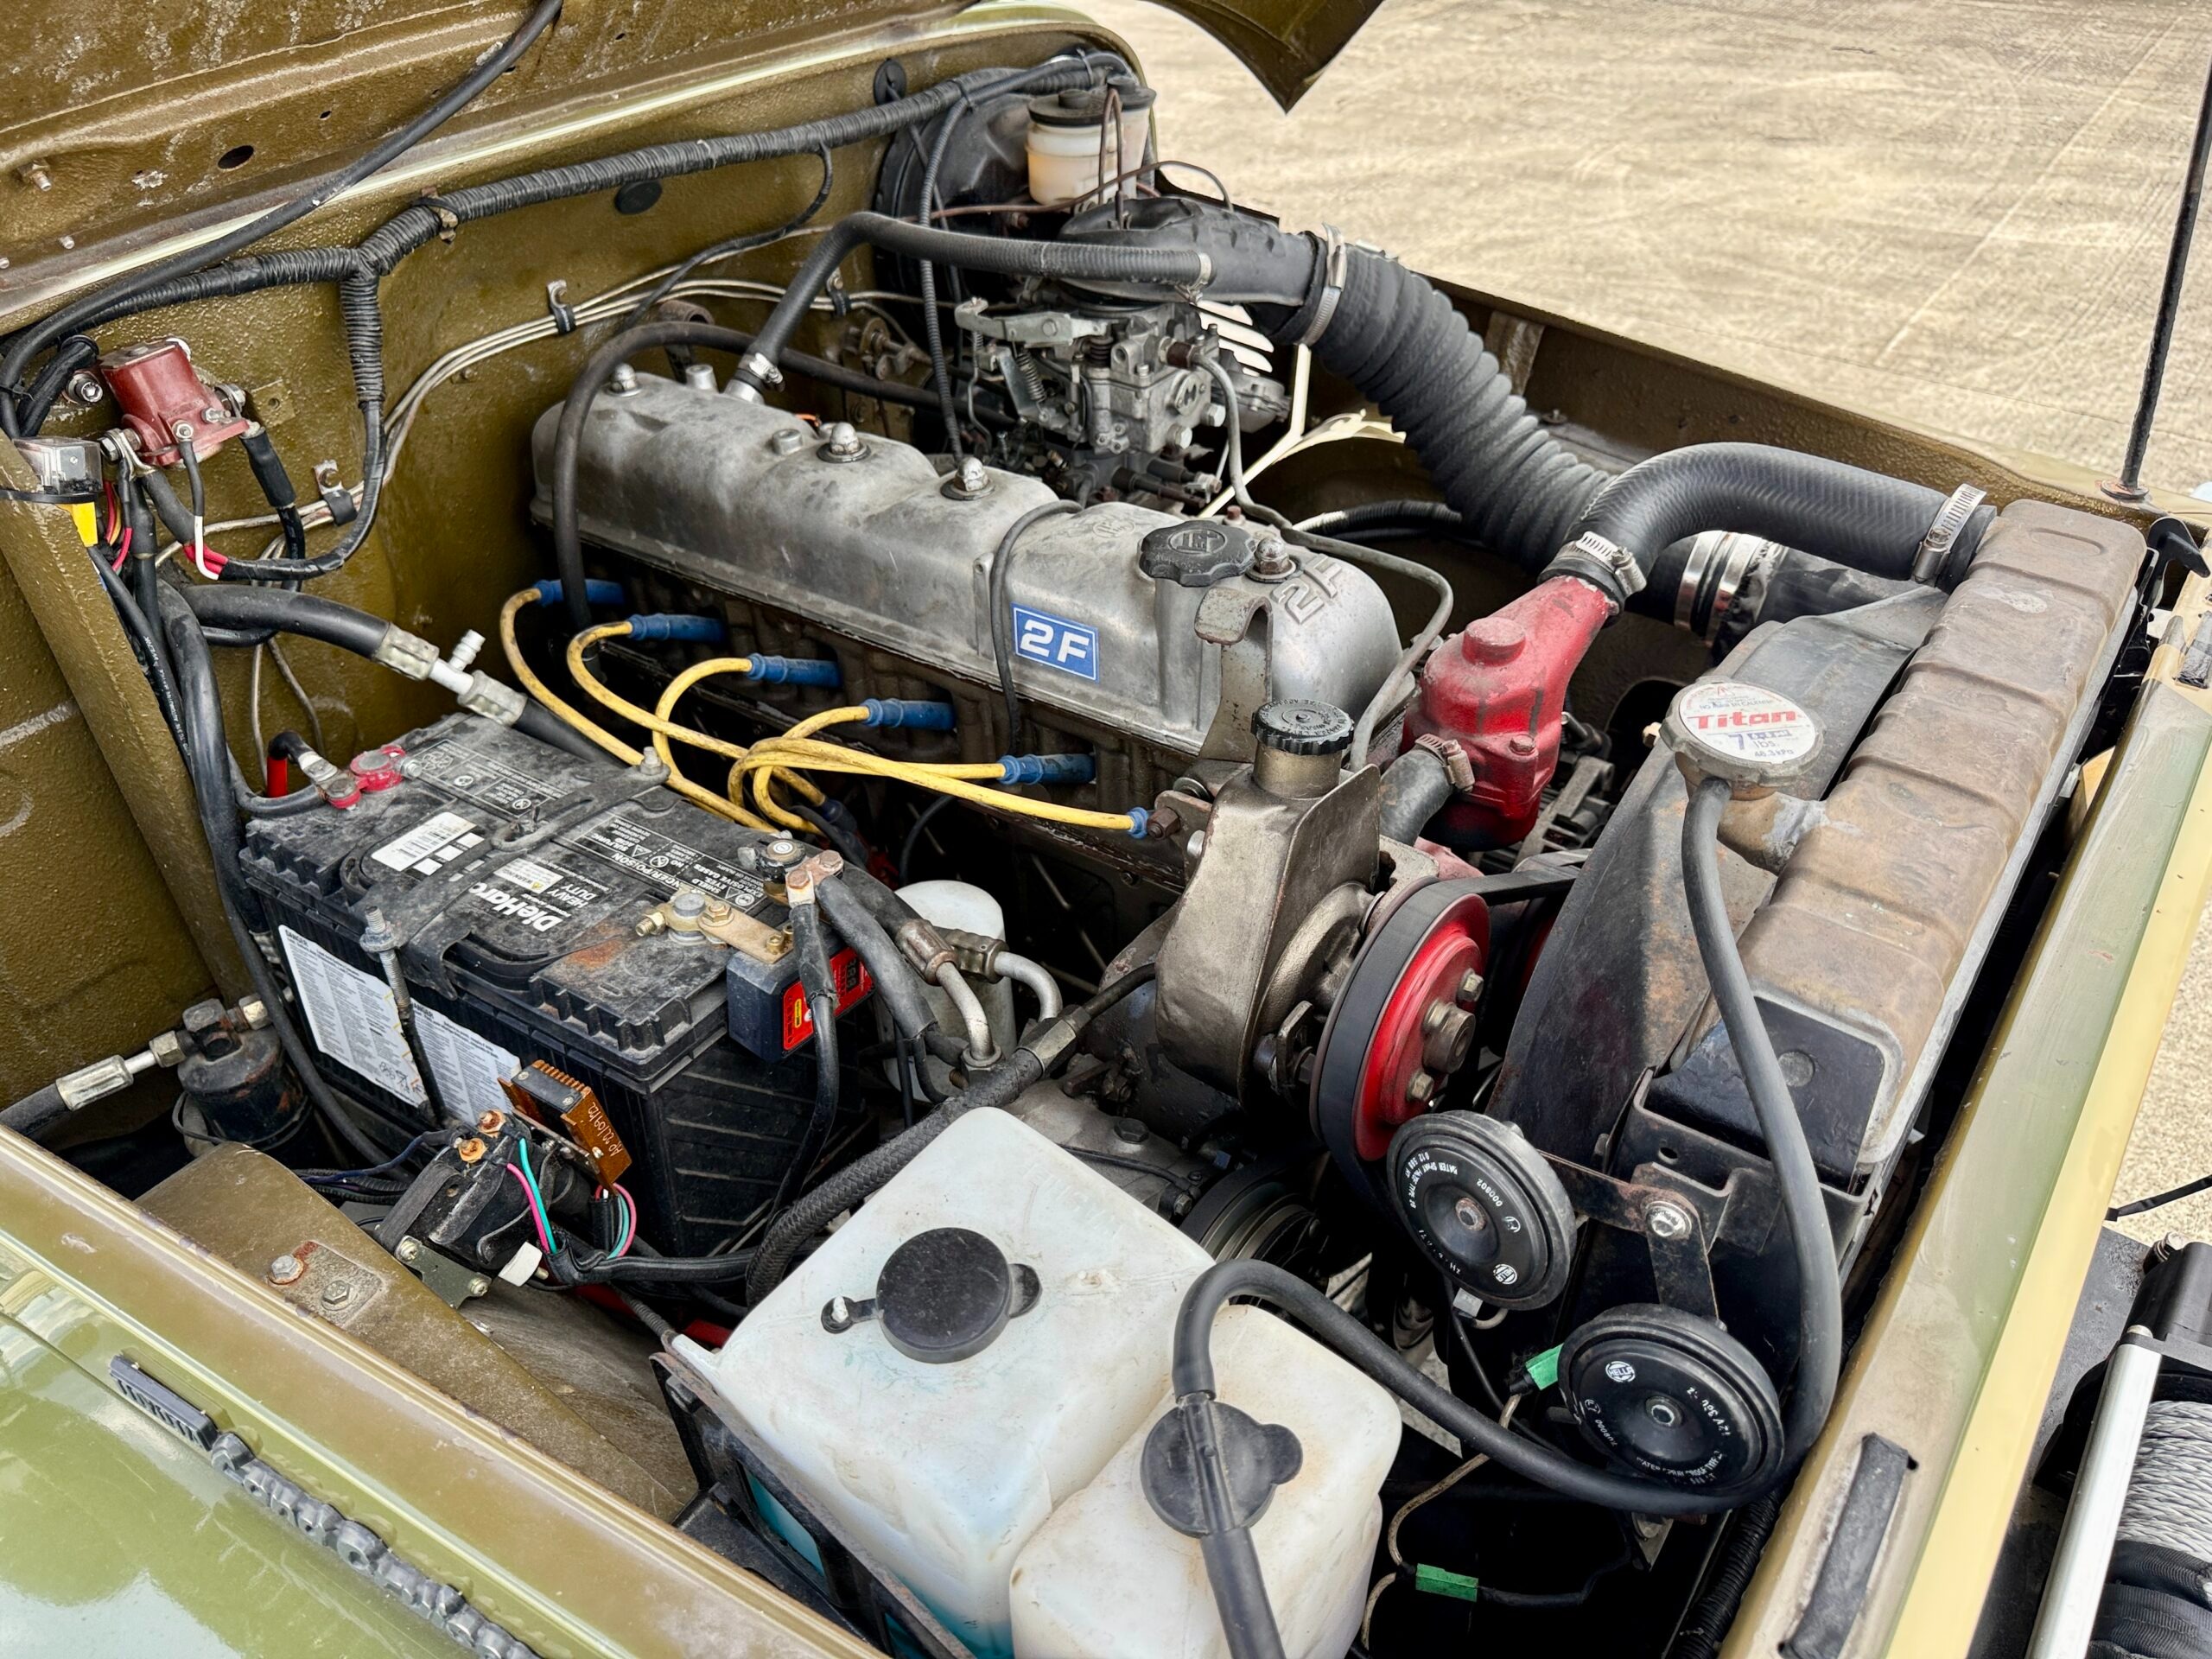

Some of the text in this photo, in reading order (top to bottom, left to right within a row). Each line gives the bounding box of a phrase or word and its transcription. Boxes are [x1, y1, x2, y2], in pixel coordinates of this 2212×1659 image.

[1268, 548, 1342, 626] 2F
[1020, 619, 1090, 663] 2F
[1688, 710, 1796, 729] Titan
[1728, 733, 1745, 750] 7
[590, 832, 628, 852] SULFURIC
[613, 836, 634, 849] ACID
[610, 851, 680, 888] NGER/POISON
[670, 858, 683, 868] NO
[690, 877, 721, 893] SHIELD
[692, 862, 763, 898] EXPLOSIVE GASES
[702, 875, 727, 889] EYES.
[546, 887, 588, 908] HEAVY
[559, 881, 596, 901] DUTY
[412, 1001, 434, 1019] ANGER
[607, 1140, 624, 1156] AP
[1438, 1162, 1458, 1175] WATER
[1477, 1178, 1503, 1207] 000802
[1608, 1365, 1634, 1376] HELLA
